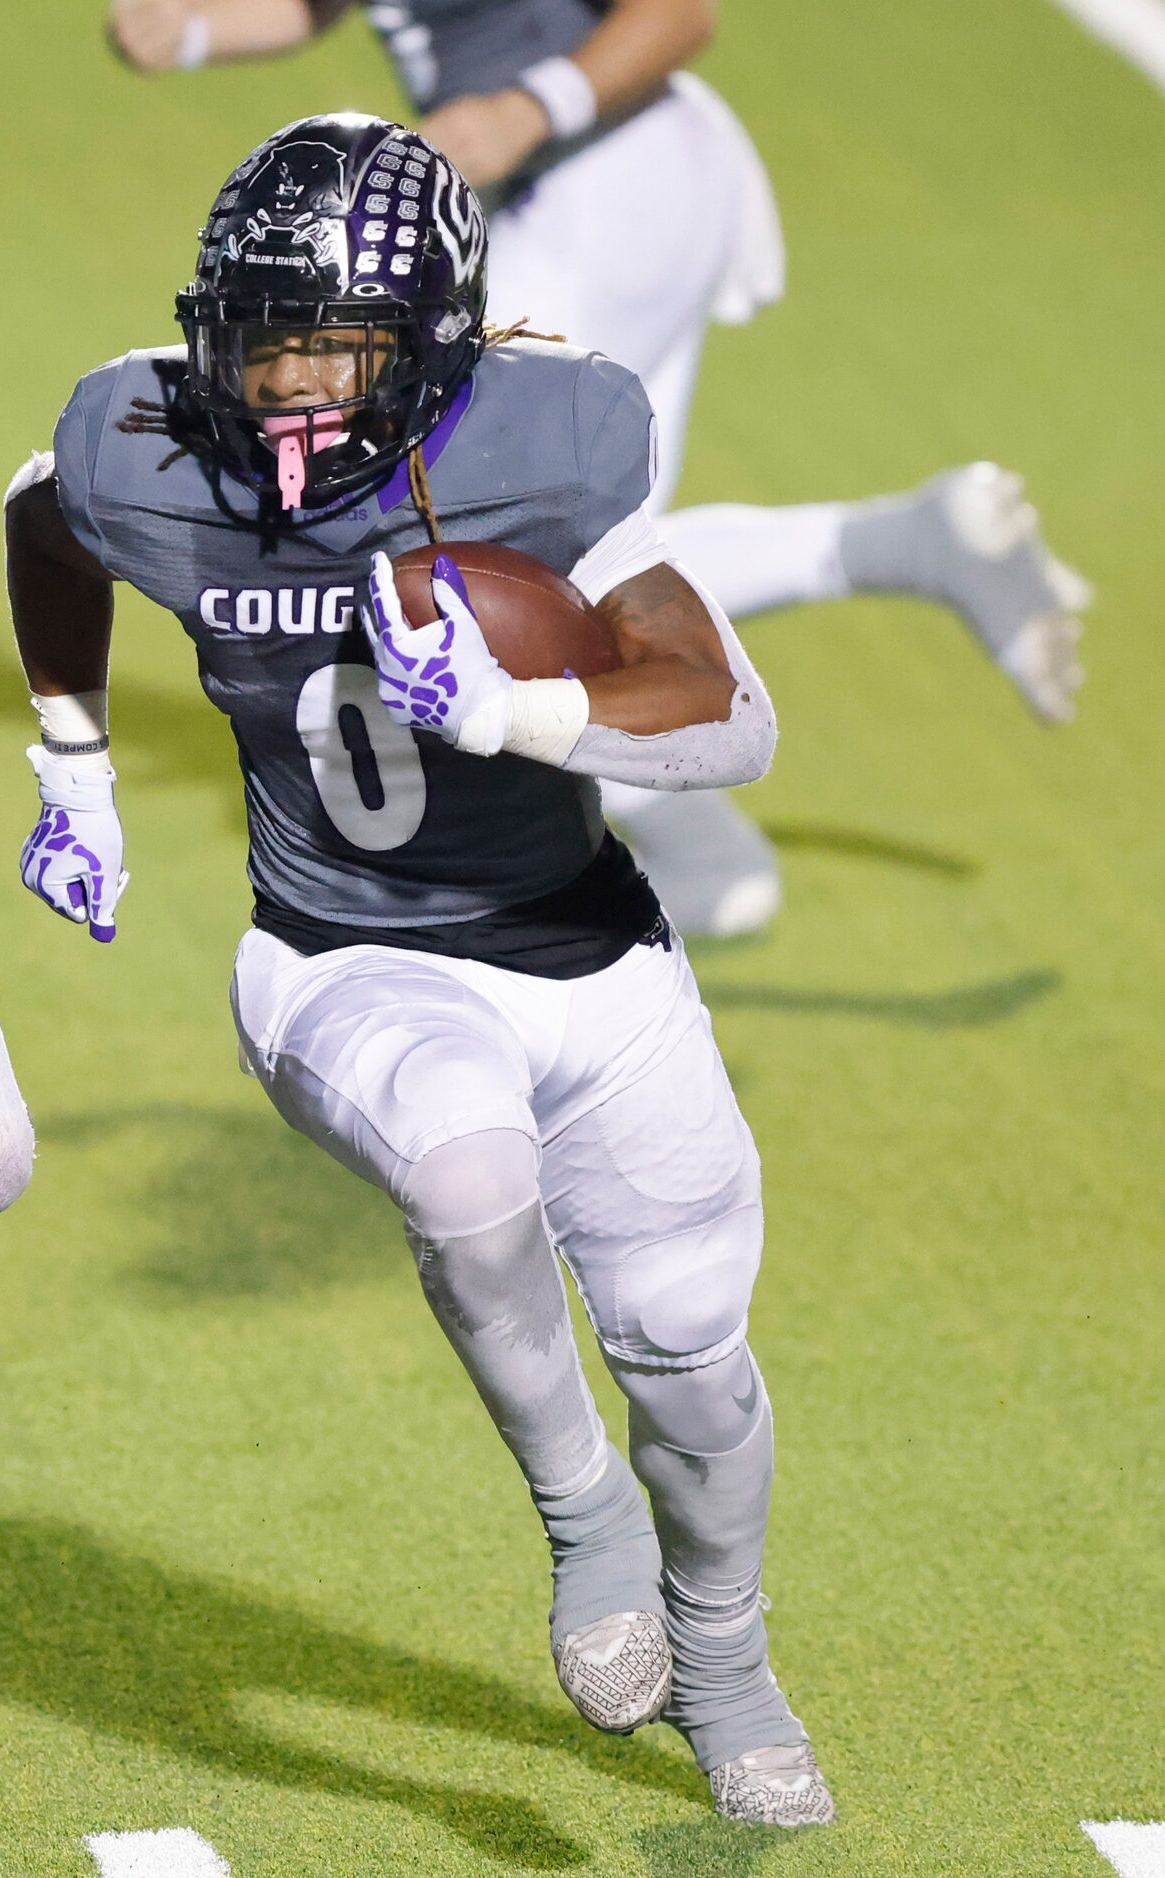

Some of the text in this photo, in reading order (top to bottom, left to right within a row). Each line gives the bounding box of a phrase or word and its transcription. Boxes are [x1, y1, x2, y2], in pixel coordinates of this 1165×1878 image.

[245, 253, 306, 267] COLLEGE STATION
[200, 586, 355, 635] COUG
[295, 663, 427, 851] 0
